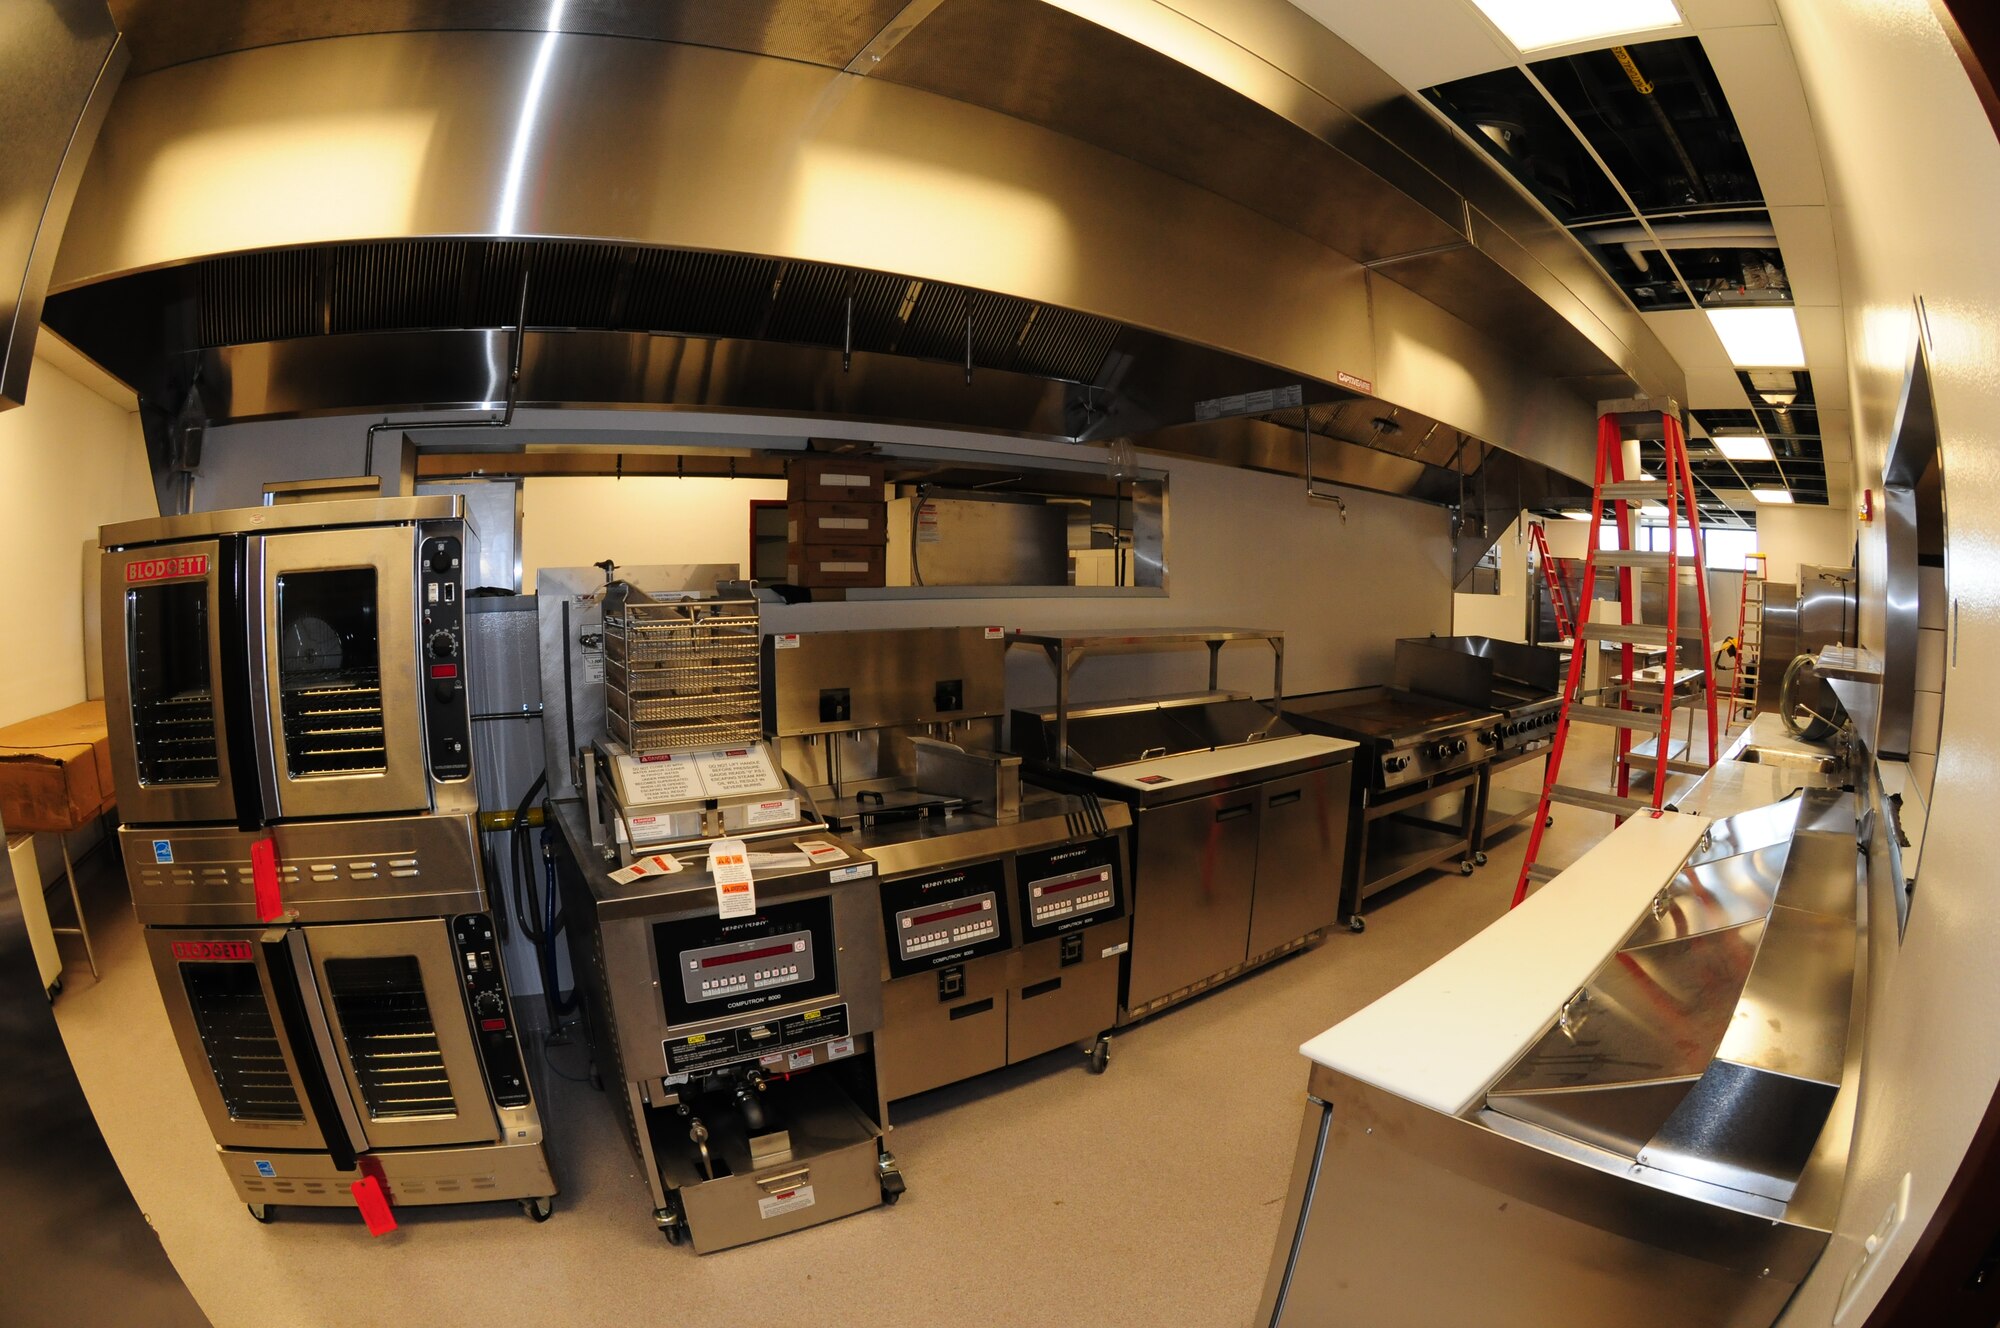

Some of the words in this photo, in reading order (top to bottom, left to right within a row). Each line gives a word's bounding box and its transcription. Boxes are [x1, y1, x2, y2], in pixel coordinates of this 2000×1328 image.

[129, 557, 203, 580] BLODGETT
[647, 754, 669, 762] DANGER
[1050, 853, 1069, 861] HENNY
[921, 880, 943, 889] HENNY
[944, 876, 965, 884] PENNY
[721, 923, 744, 932] HENNY
[745, 920, 767, 928] PENNY
[1058, 920, 1083, 931] COMPUTRON
[932, 953, 962, 964] COMPUTRON
[727, 997, 764, 1009] COMPUTRON
